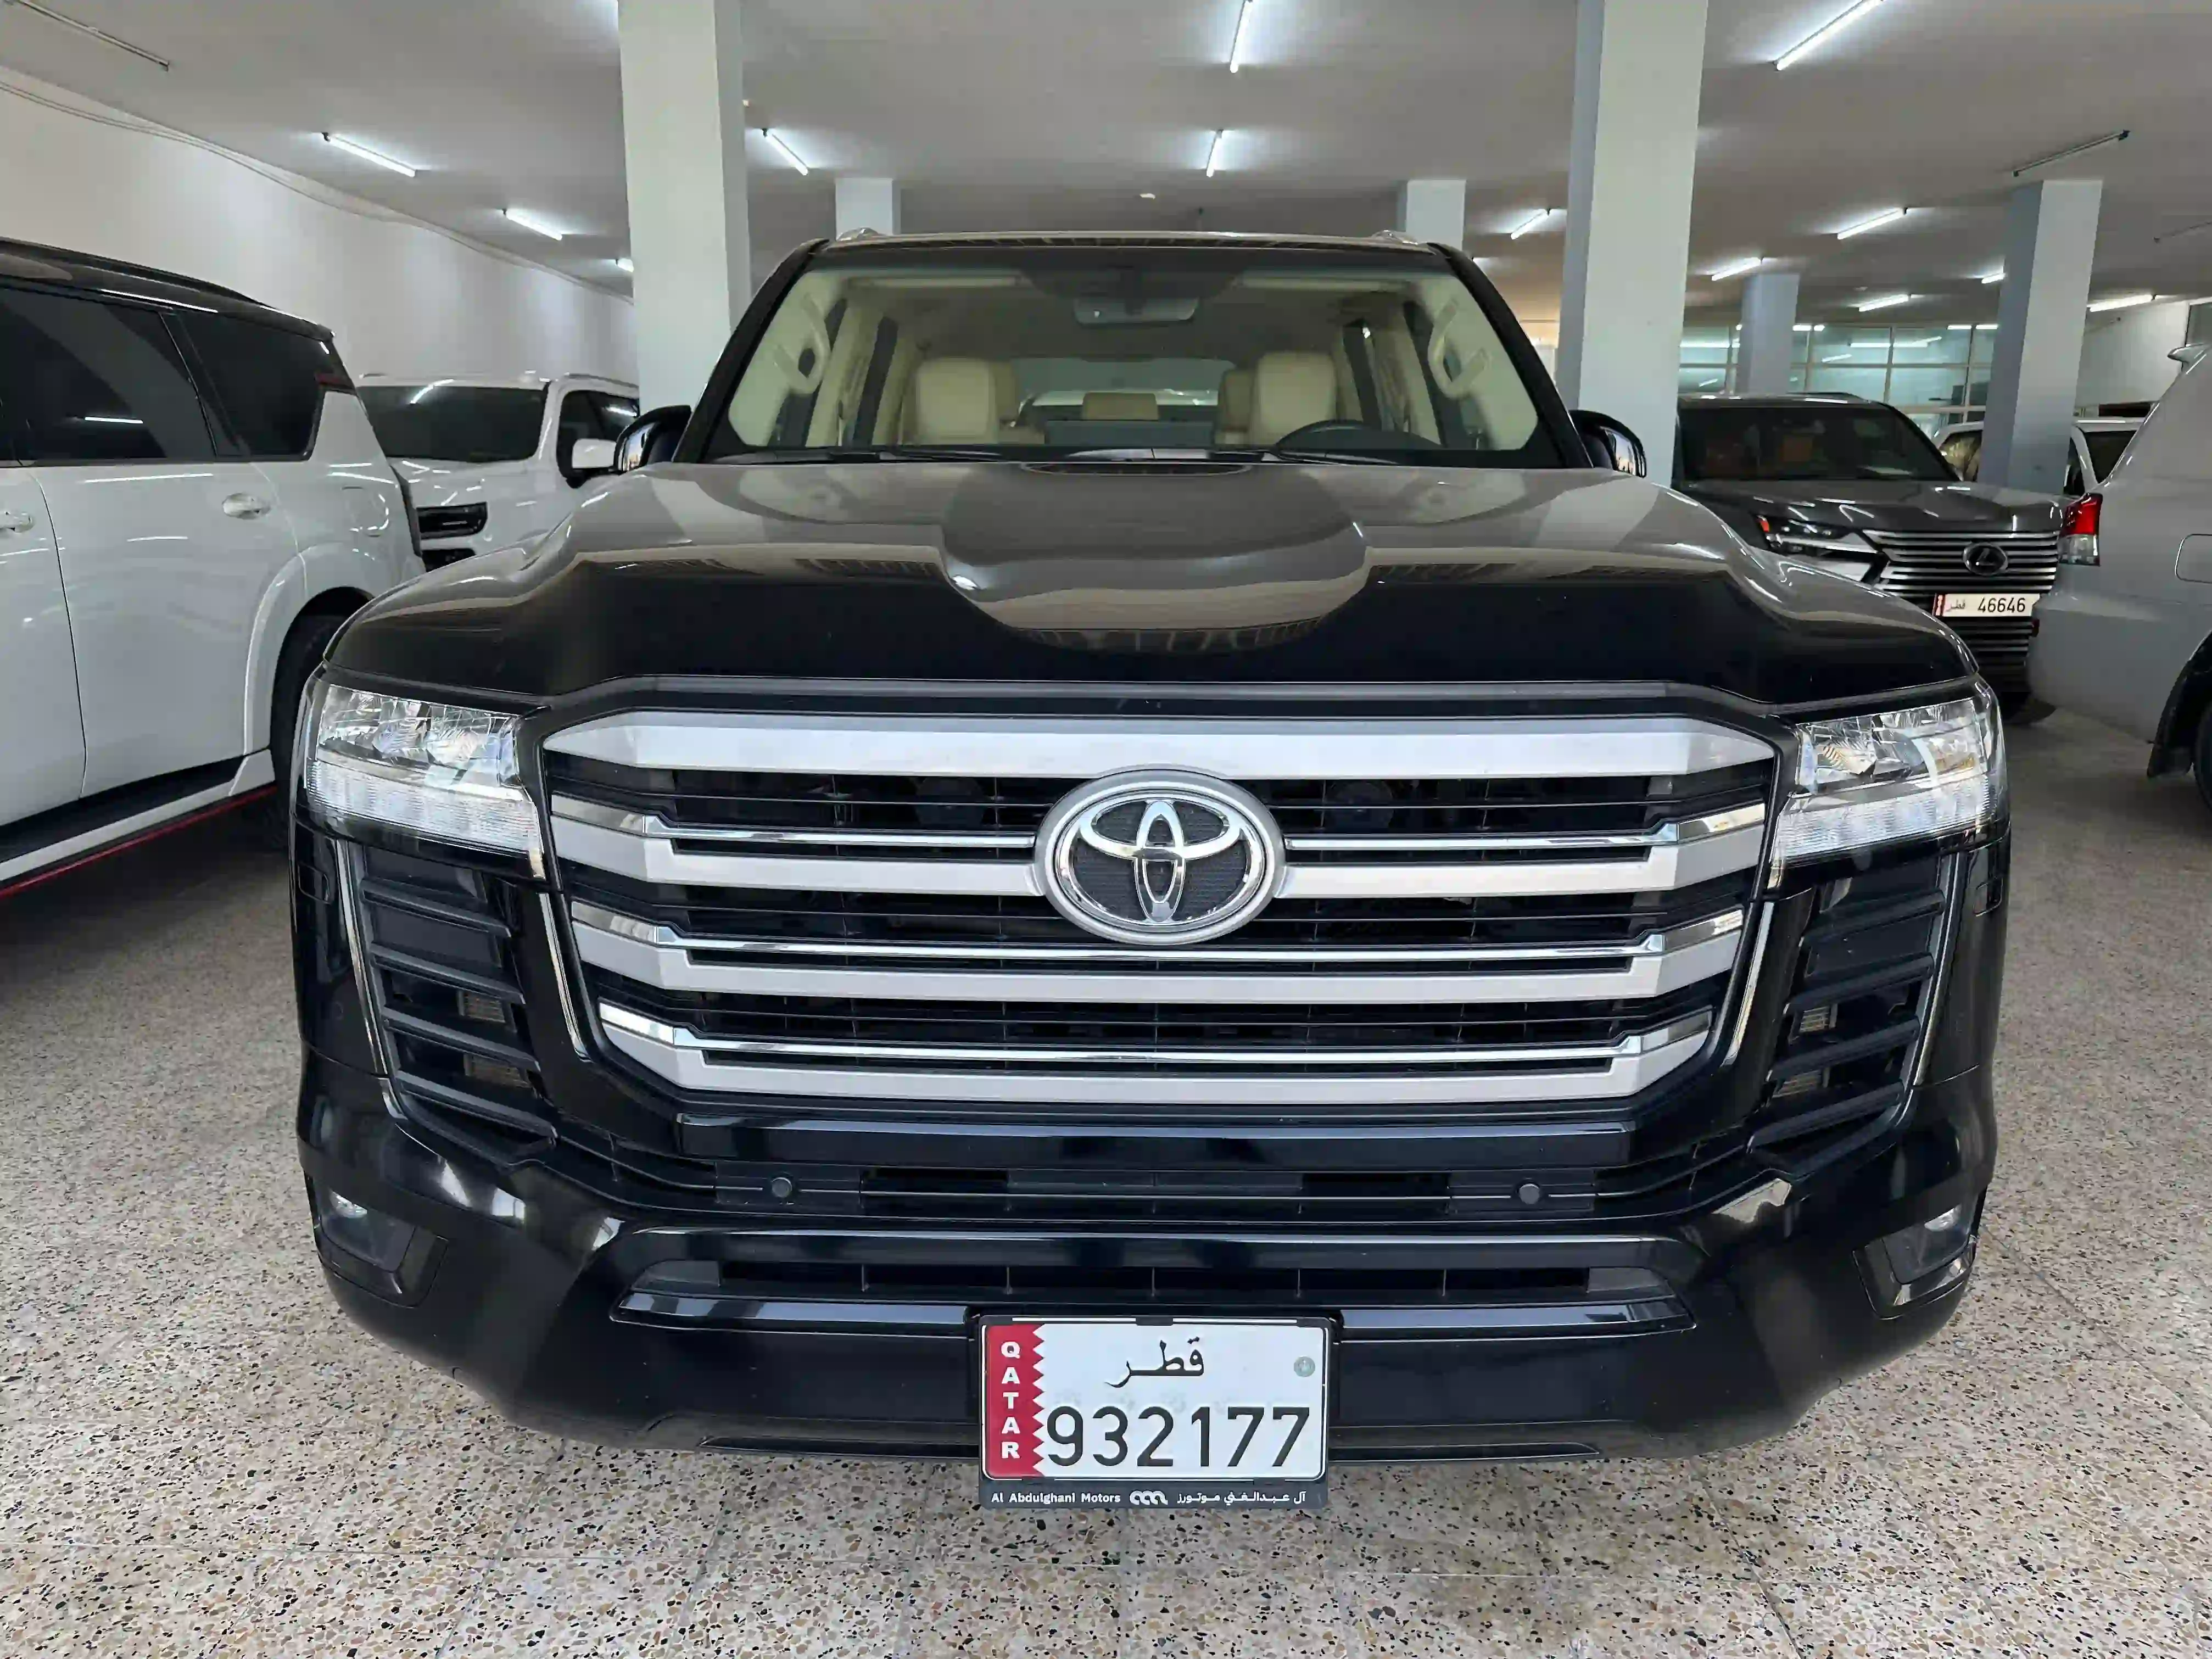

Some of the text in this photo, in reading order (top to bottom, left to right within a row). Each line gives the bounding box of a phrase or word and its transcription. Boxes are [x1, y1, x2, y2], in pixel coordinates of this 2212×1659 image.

[1978, 597, 2026, 613] 46646
[1104, 1336, 1205, 1388] قطر
[1001, 1341, 1021, 1459] QATAR
[1047, 1406, 1310, 1467] 932177
[991, 1492, 1121, 1504] Al Abdulghani Motors
[1177, 1492, 1221, 1504] موتورز
